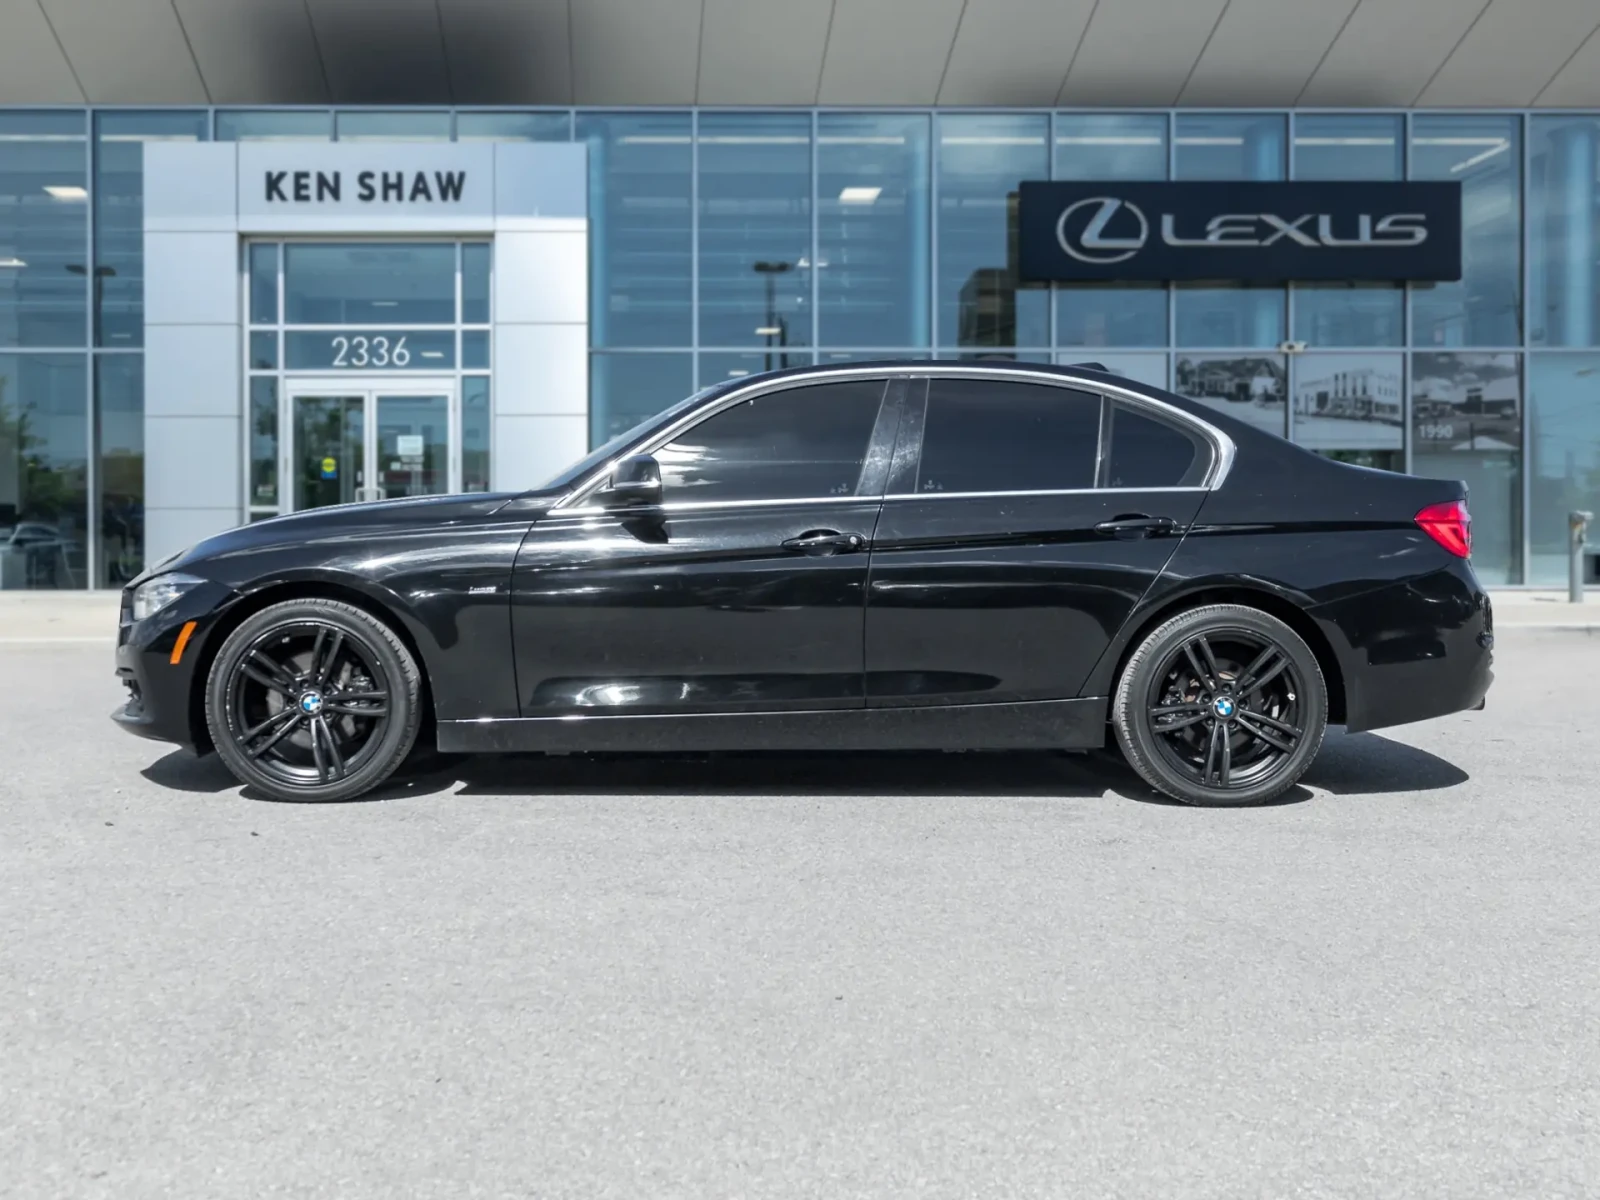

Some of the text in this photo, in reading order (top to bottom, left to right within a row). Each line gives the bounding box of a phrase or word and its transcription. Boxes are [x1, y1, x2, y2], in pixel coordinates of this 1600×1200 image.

[265, 171, 467, 202] KEN SHAW
[1161, 213, 1428, 246] LEXUS
[331, 336, 410, 366] 2336
[1419, 424, 1453, 439] 1990
